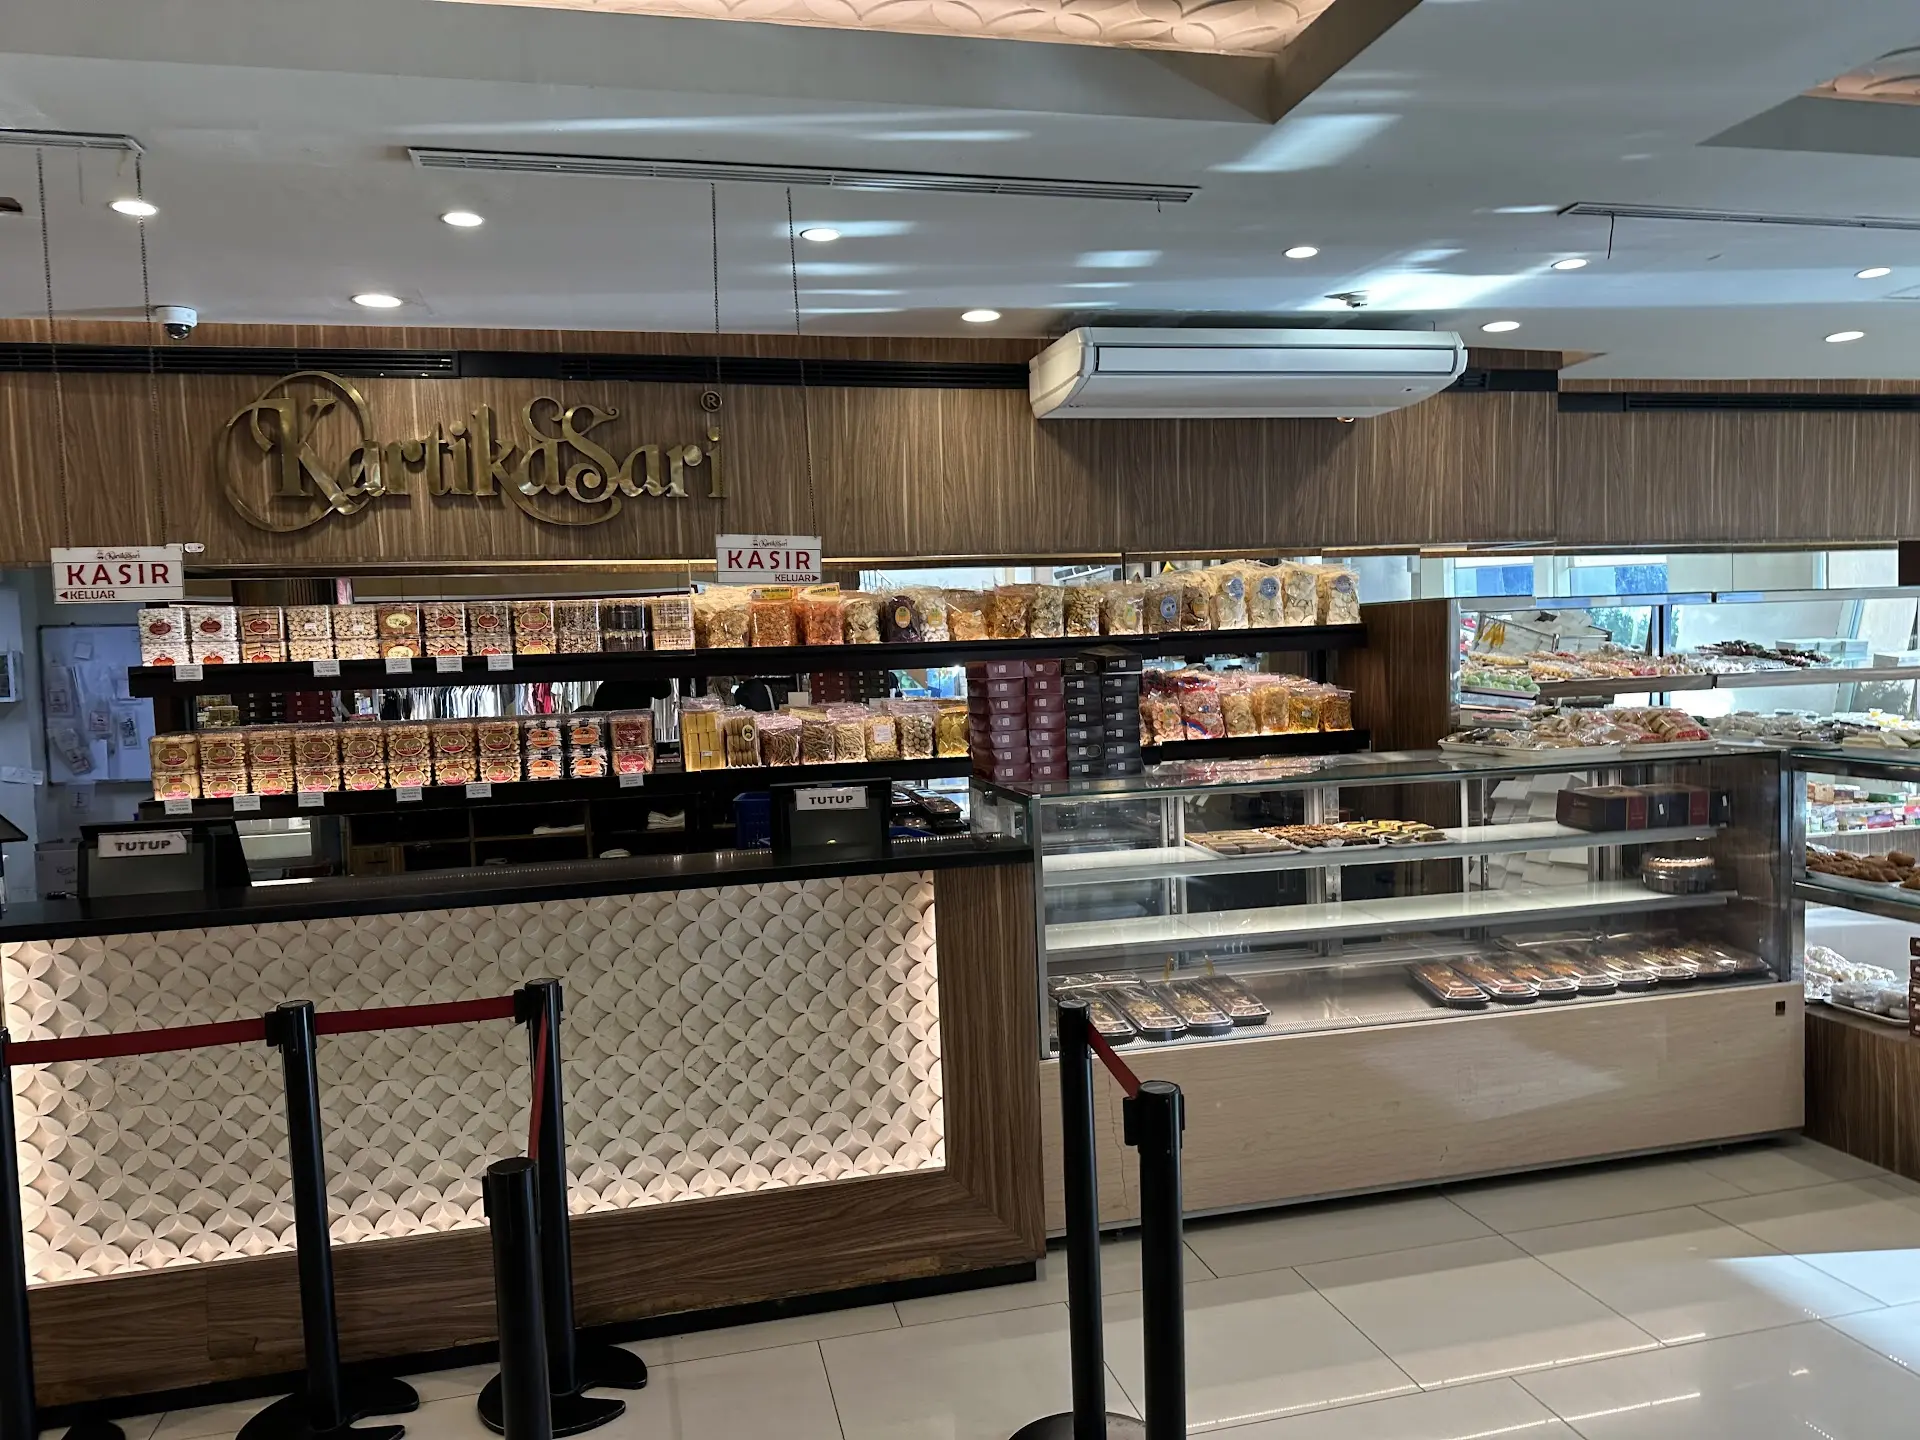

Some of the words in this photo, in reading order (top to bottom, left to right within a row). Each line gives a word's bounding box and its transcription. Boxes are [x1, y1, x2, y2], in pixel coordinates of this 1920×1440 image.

[727, 549, 811, 570] KASIR
[66, 563, 170, 586] KASIR
[774, 573, 811, 583] KELUAR
[70, 590, 115, 600] KELUAR
[809, 795, 853, 805] TUTUP
[114, 839, 171, 852] TUTUP
